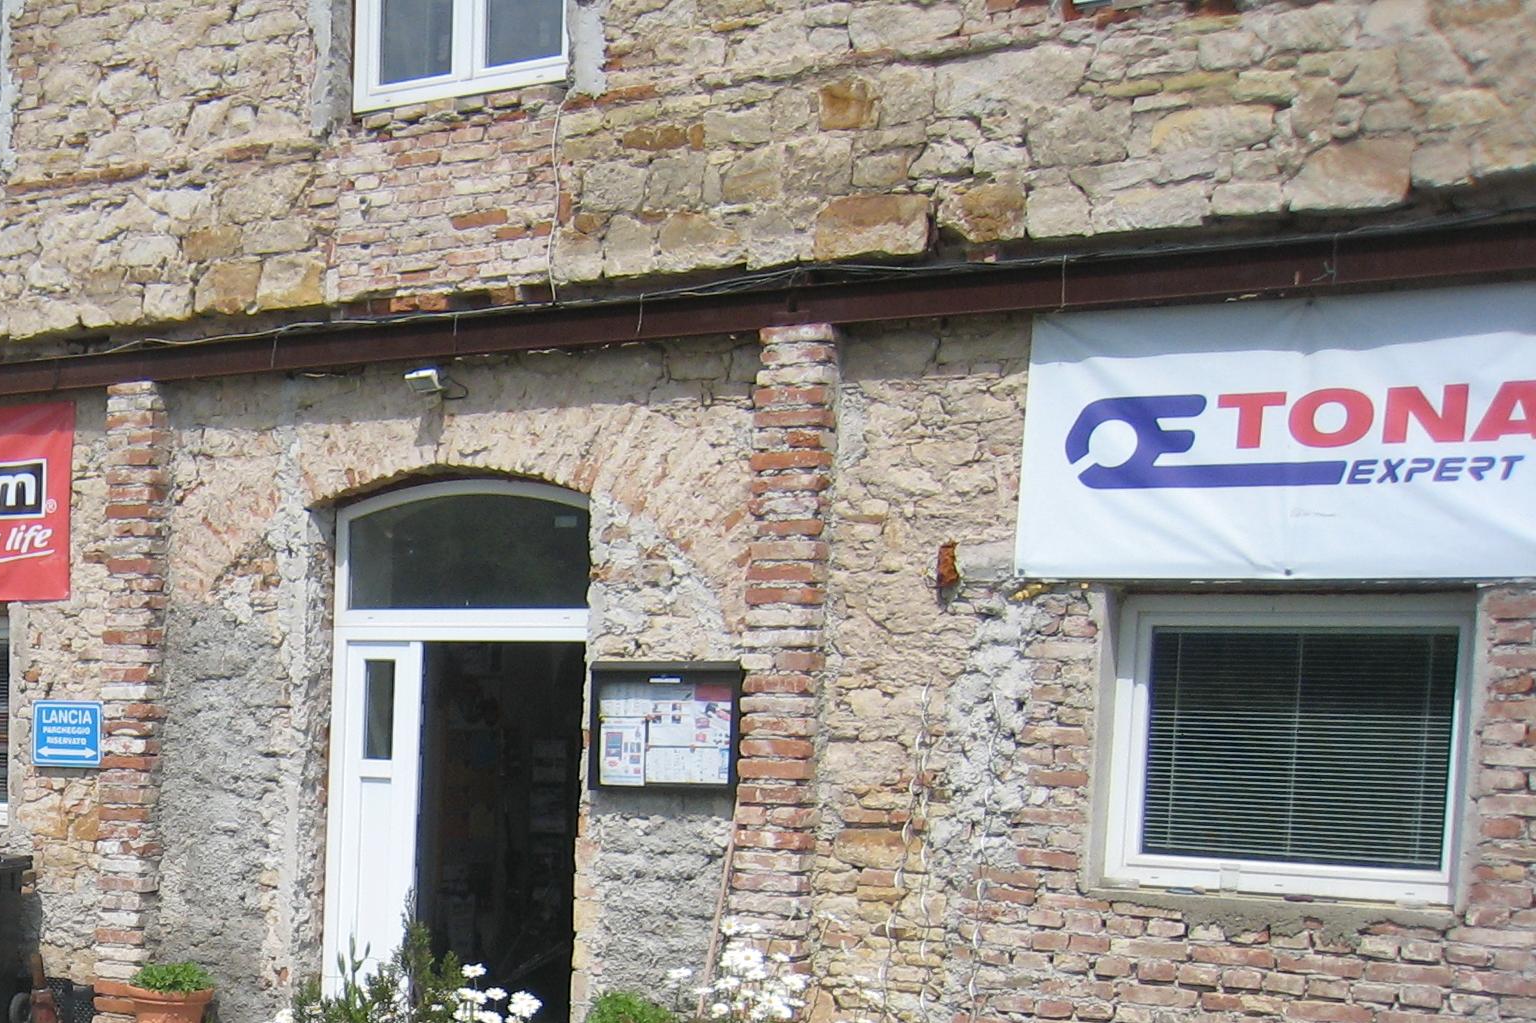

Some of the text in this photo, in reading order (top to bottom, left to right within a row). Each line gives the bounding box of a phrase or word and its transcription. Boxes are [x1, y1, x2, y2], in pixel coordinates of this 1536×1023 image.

[1217, 380, 1536, 449] TONA
[1346, 455, 1525, 485] EXPERT
[5, 524, 53, 553] life
[42, 709, 92, 725] LANCIA
